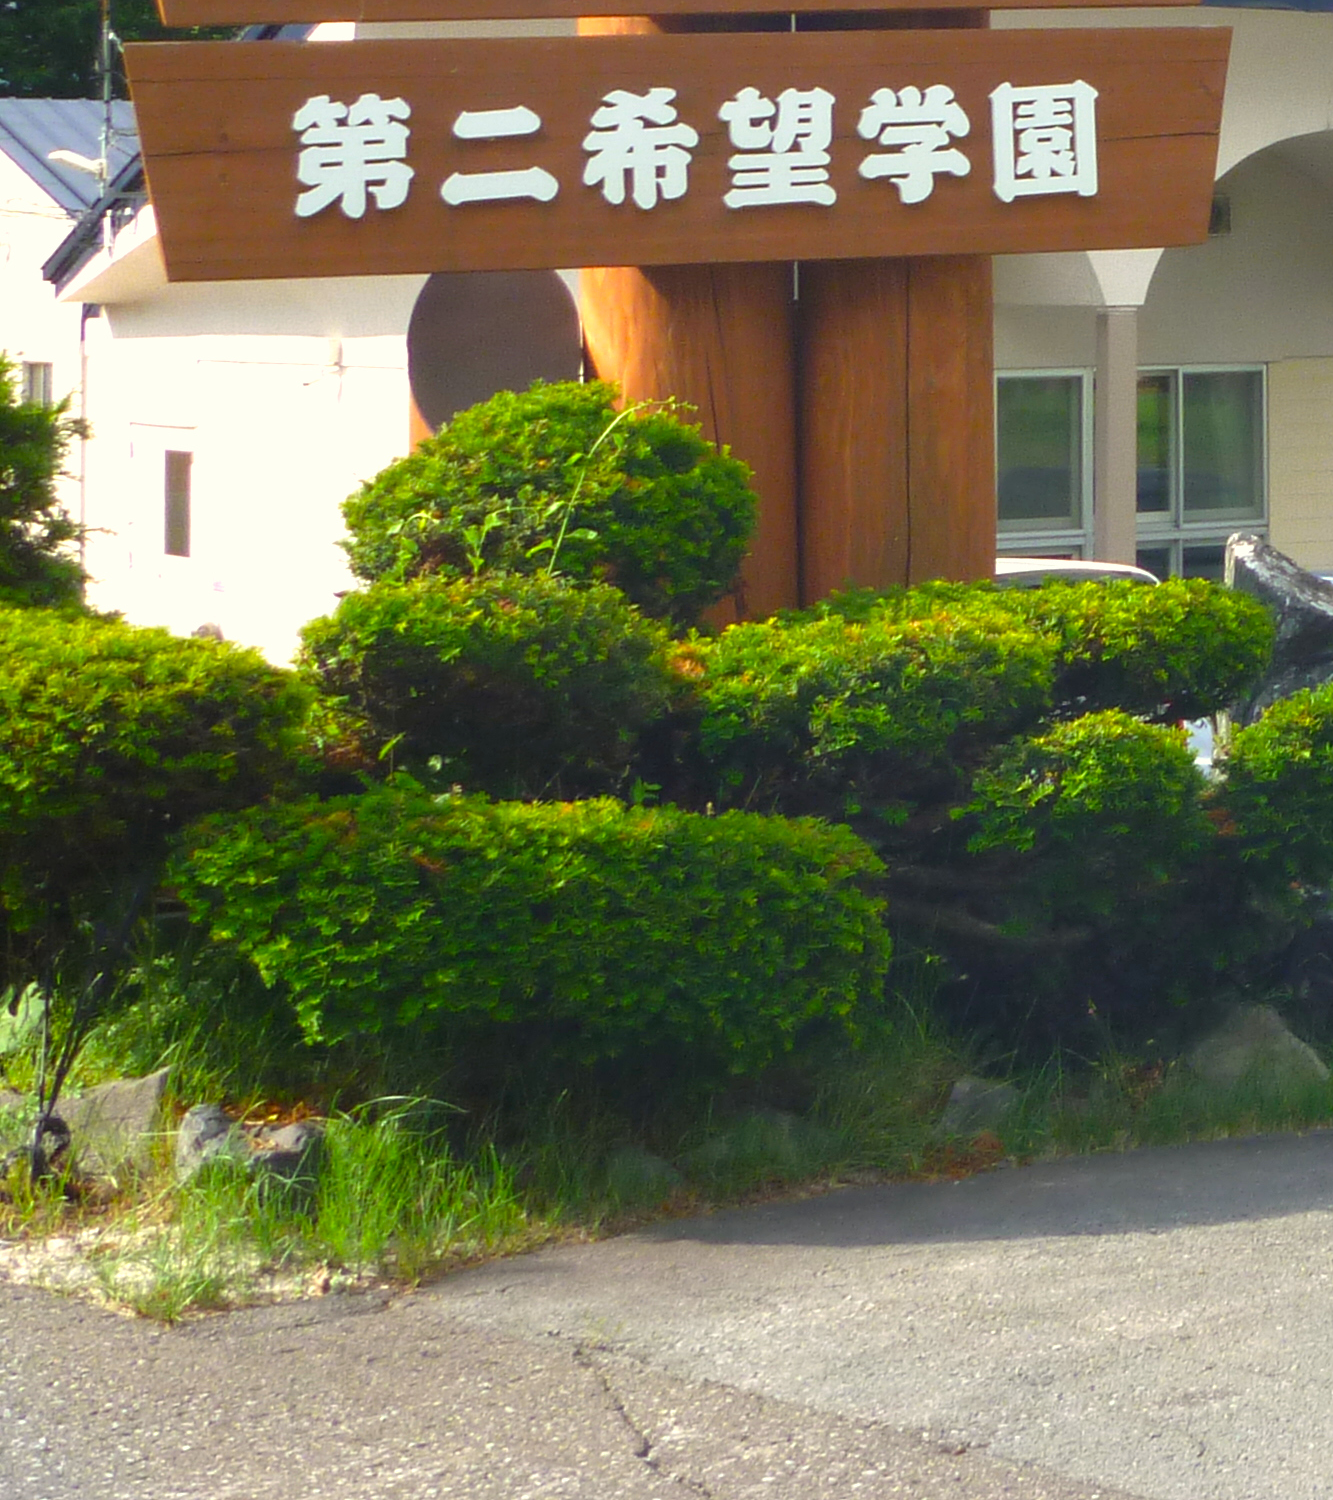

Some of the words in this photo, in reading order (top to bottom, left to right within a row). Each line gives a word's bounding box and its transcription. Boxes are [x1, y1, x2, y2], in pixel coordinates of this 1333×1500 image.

[291, 79, 1100, 221] 第二希望学園
